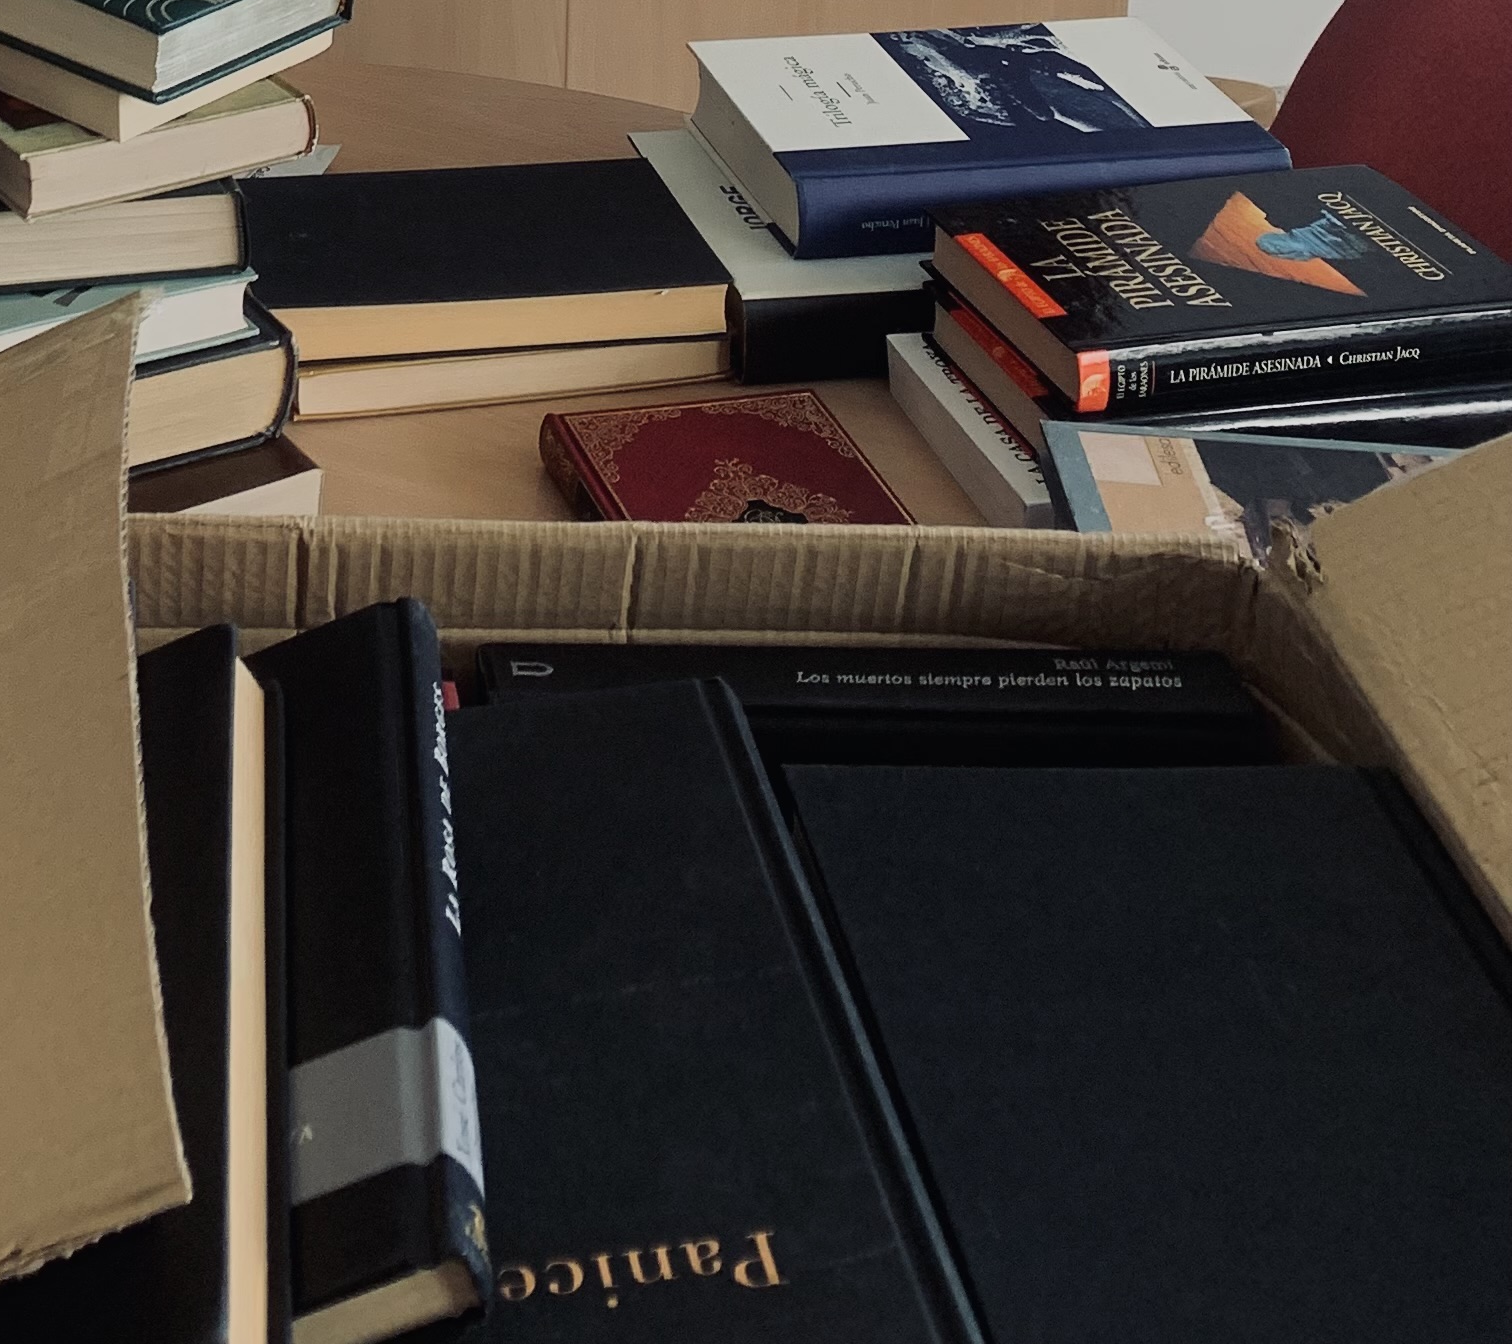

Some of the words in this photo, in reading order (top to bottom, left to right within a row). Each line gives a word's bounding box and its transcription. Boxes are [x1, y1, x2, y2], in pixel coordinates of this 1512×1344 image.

[783, 55, 820, 94] mágica
[809, 90, 852, 128] Trilogía
[719, 185, 768, 230] JORGE
[903, 216, 923, 228] Juan
[1317, 191, 1373, 220] JACQ
[862, 218, 900, 231] Perucho
[1039, 217, 1176, 312] PIRÁMIDE
[1087, 208, 1234, 308] ASESINADA
[1352, 220, 1445, 282] CHRISTIAN
[1030, 254, 1087, 282] LA
[1117, 364, 1125, 391] EGIPTO
[1129, 371, 1137, 383] los
[1170, 369, 1186, 384] LA
[1188, 360, 1250, 383] PIRÁMIDE
[1252, 355, 1322, 376] ASESINADA
[1339, 347, 1393, 366] CHRISTIAN
[1394, 345, 1421, 362] JACQ
[1129, 382, 1137, 391] de
[797, 672, 831, 685] Los
[836, 674, 912, 687] muertos
[918, 674, 991, 689] siempre
[998, 674, 1069, 689] pierden
[1076, 674, 1102, 688] los
[1109, 676, 1183, 690] zapatos
[496, 1230, 791, 1310] Panice
